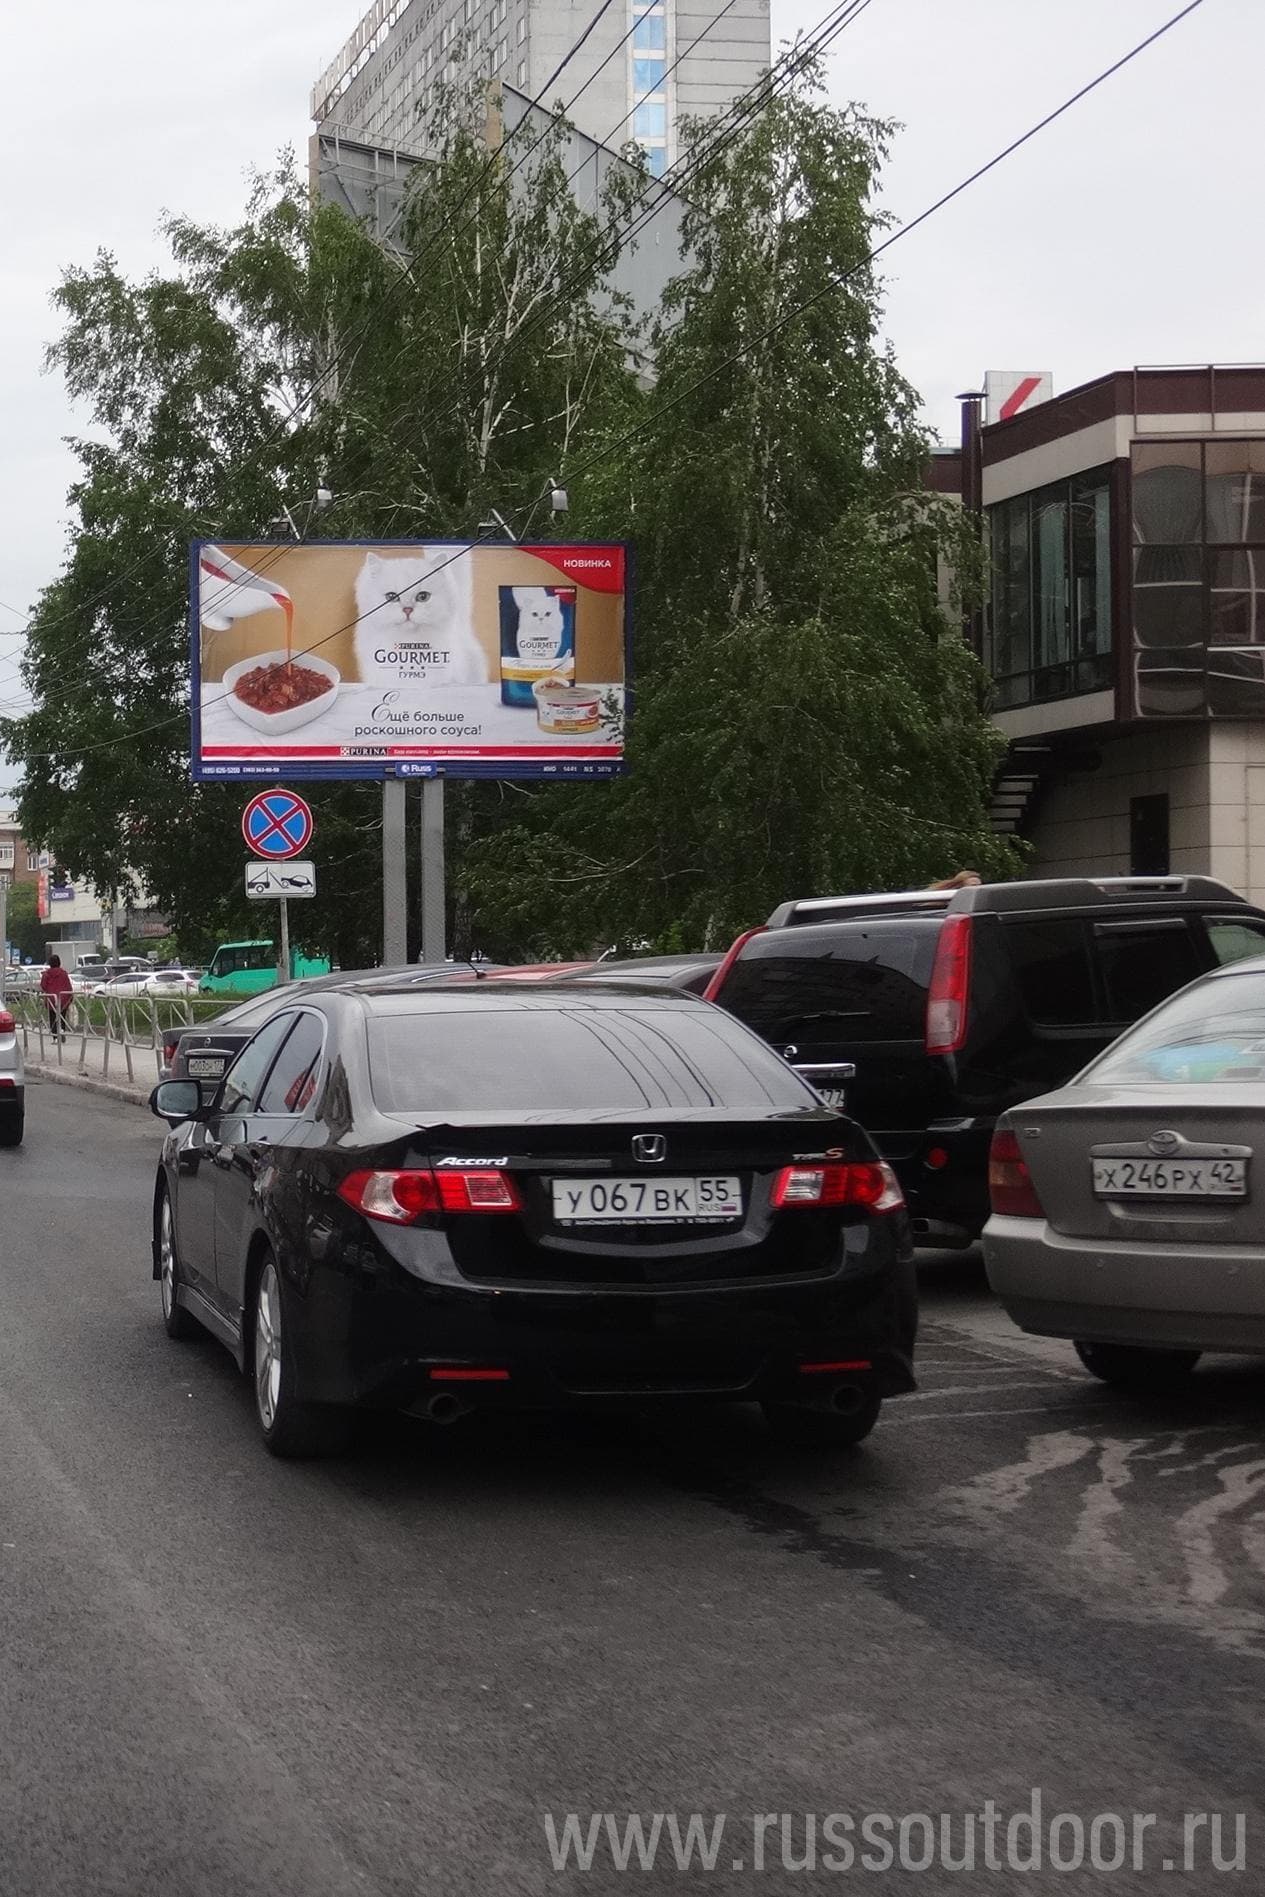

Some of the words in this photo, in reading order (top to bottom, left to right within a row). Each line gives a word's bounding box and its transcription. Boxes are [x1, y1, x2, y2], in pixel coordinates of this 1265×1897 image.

[563, 559, 612, 568] НОВИНКА
[374, 649, 450, 665] GOURMET
[398, 671, 427, 679] ГУРМЭ
[371, 690, 410, 722] Ещё
[413, 711, 465, 722] больше
[354, 725, 438, 737] роскошного
[440, 725, 482, 737] соуса!
[349, 747, 389, 756] PURINA
[436, 1157, 509, 1166] Accord
[1103, 1163, 1203, 1190] Х246РХ
[1211, 1162, 1237, 1183] 42
[700, 1180, 730, 1202] 55
[697, 1202, 721, 1212] RUS
